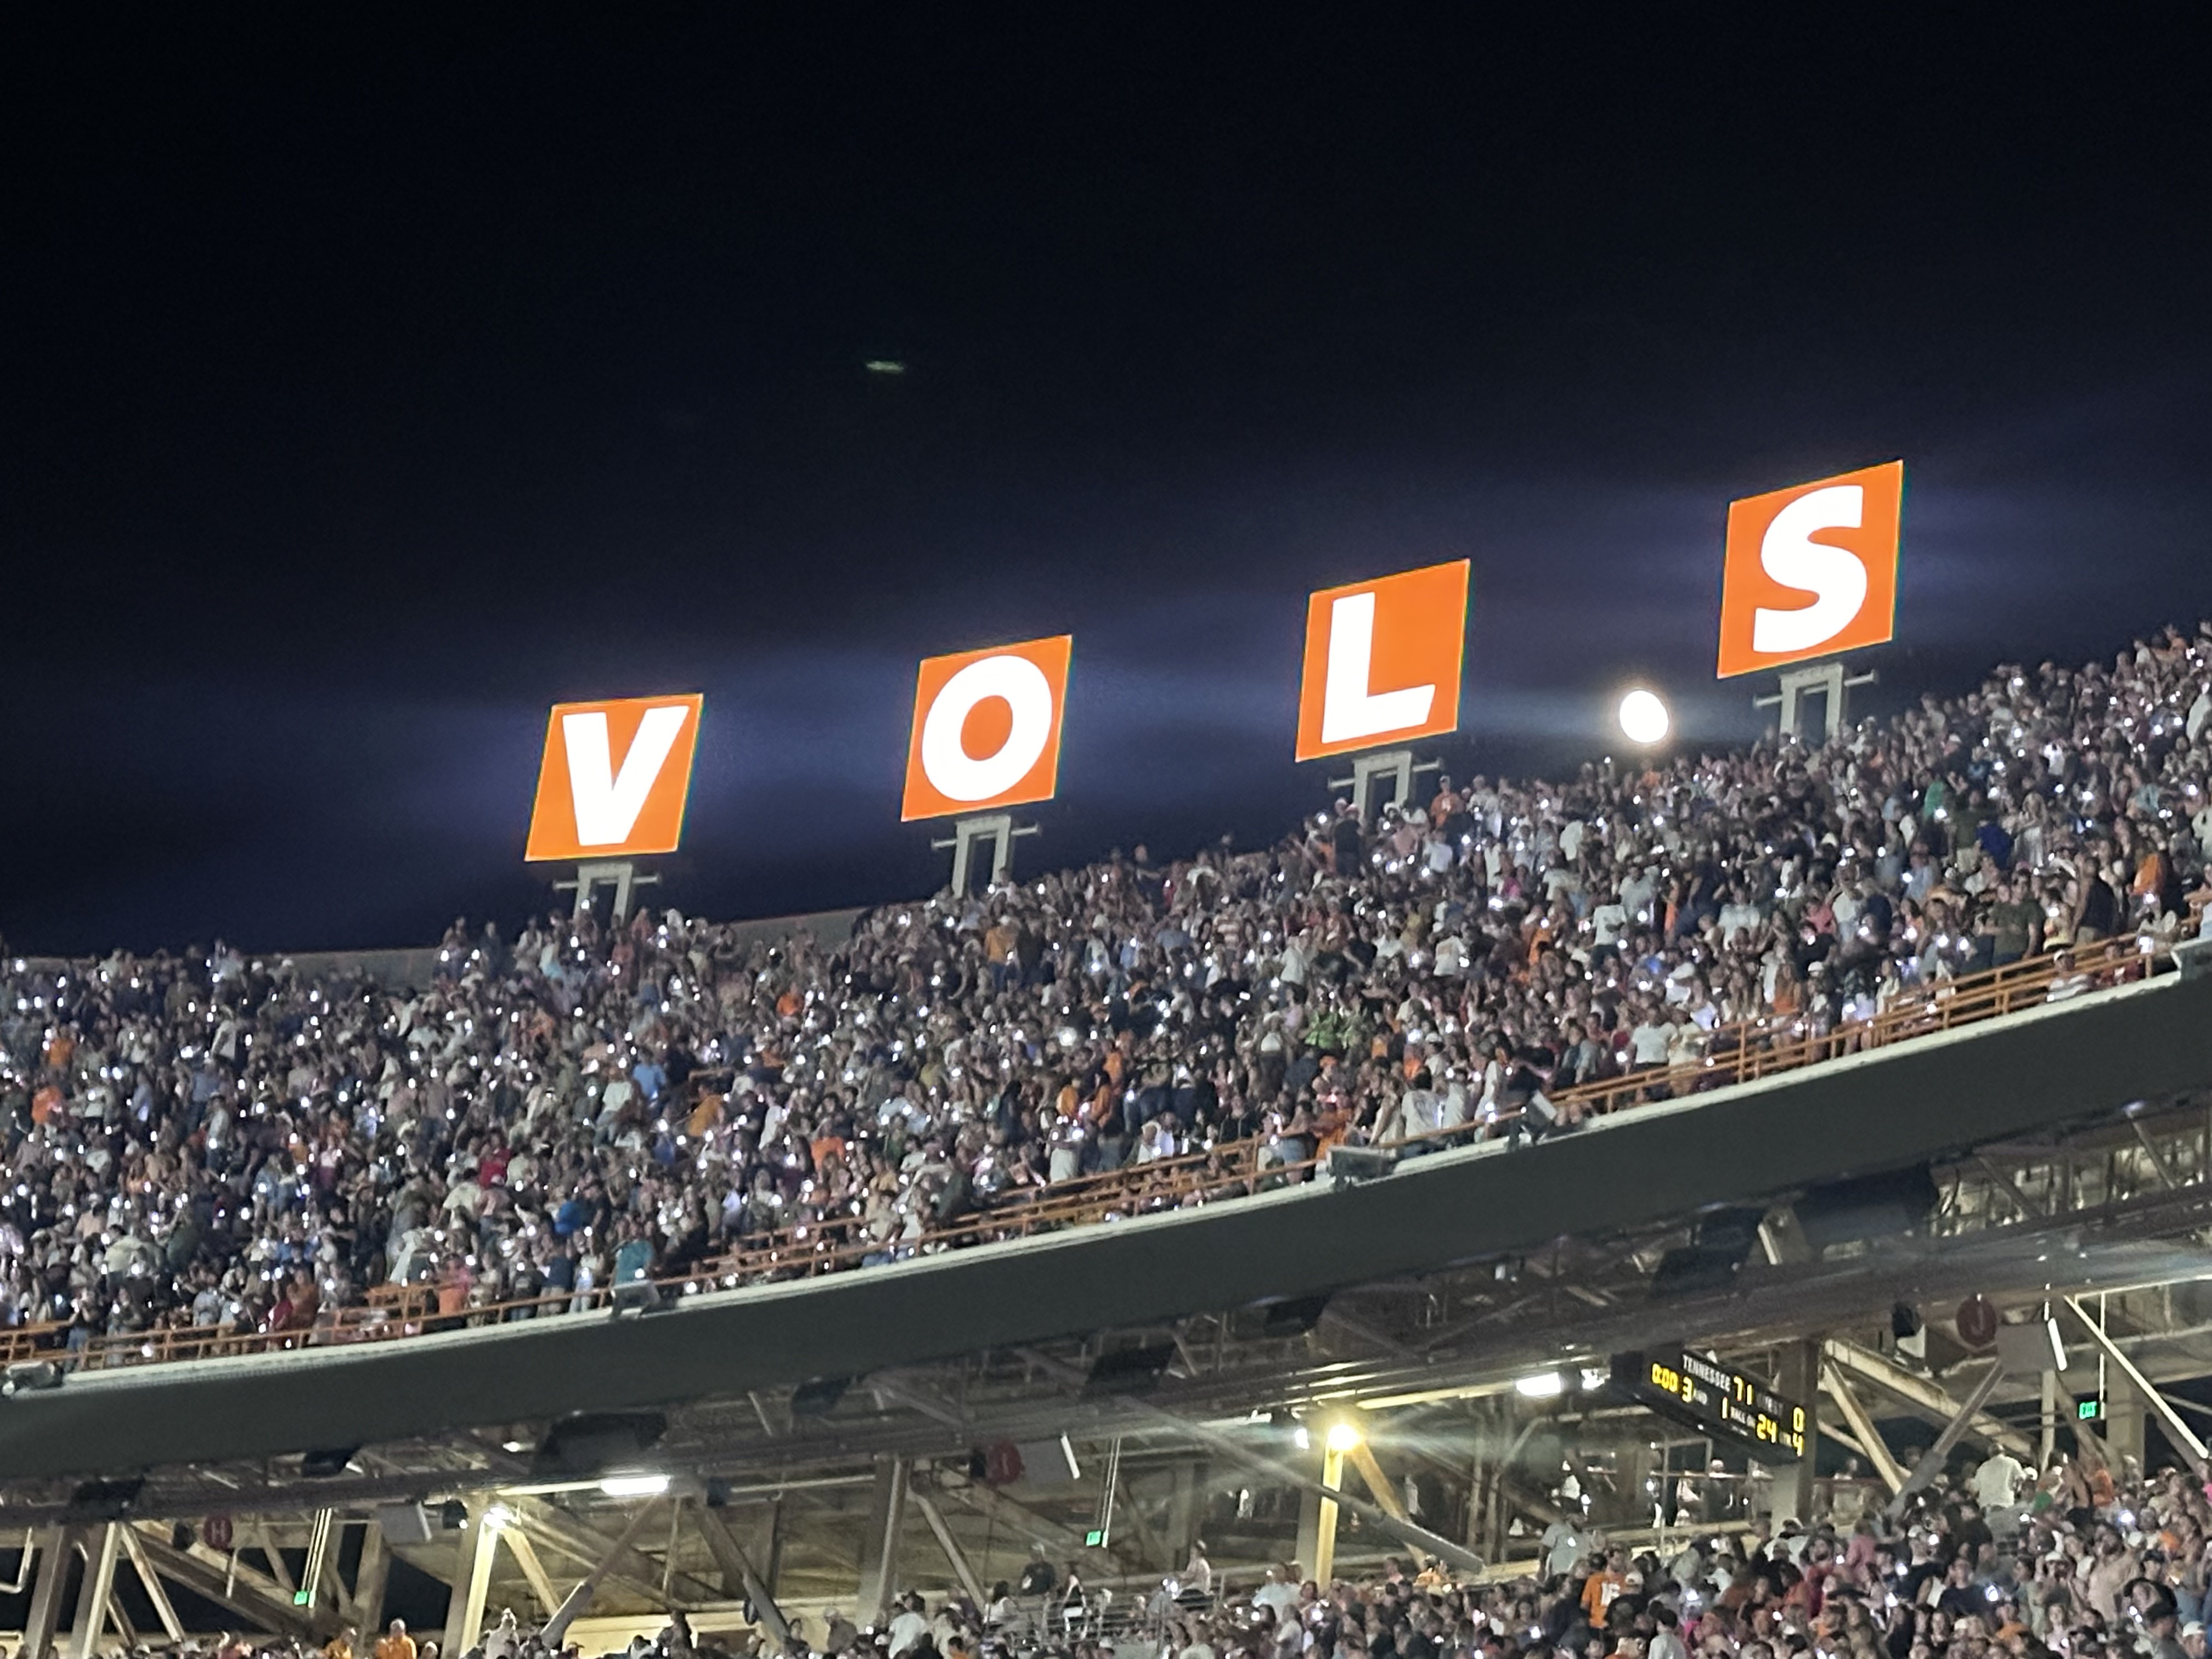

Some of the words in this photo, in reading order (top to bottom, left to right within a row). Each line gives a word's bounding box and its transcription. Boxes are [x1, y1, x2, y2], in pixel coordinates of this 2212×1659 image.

[1652, 1363, 1678, 1392] 0:00
[1683, 1354, 1730, 1392] TENNESSEE
[1734, 1376, 1752, 1405] 71
[1682, 1376, 1692, 1403] 3
[1722, 1397, 1728, 1419] 1
[1757, 1413, 1776, 1443] 24
[1793, 1407, 1804, 1432] 0
[1792, 1432, 1803, 1457] 4
